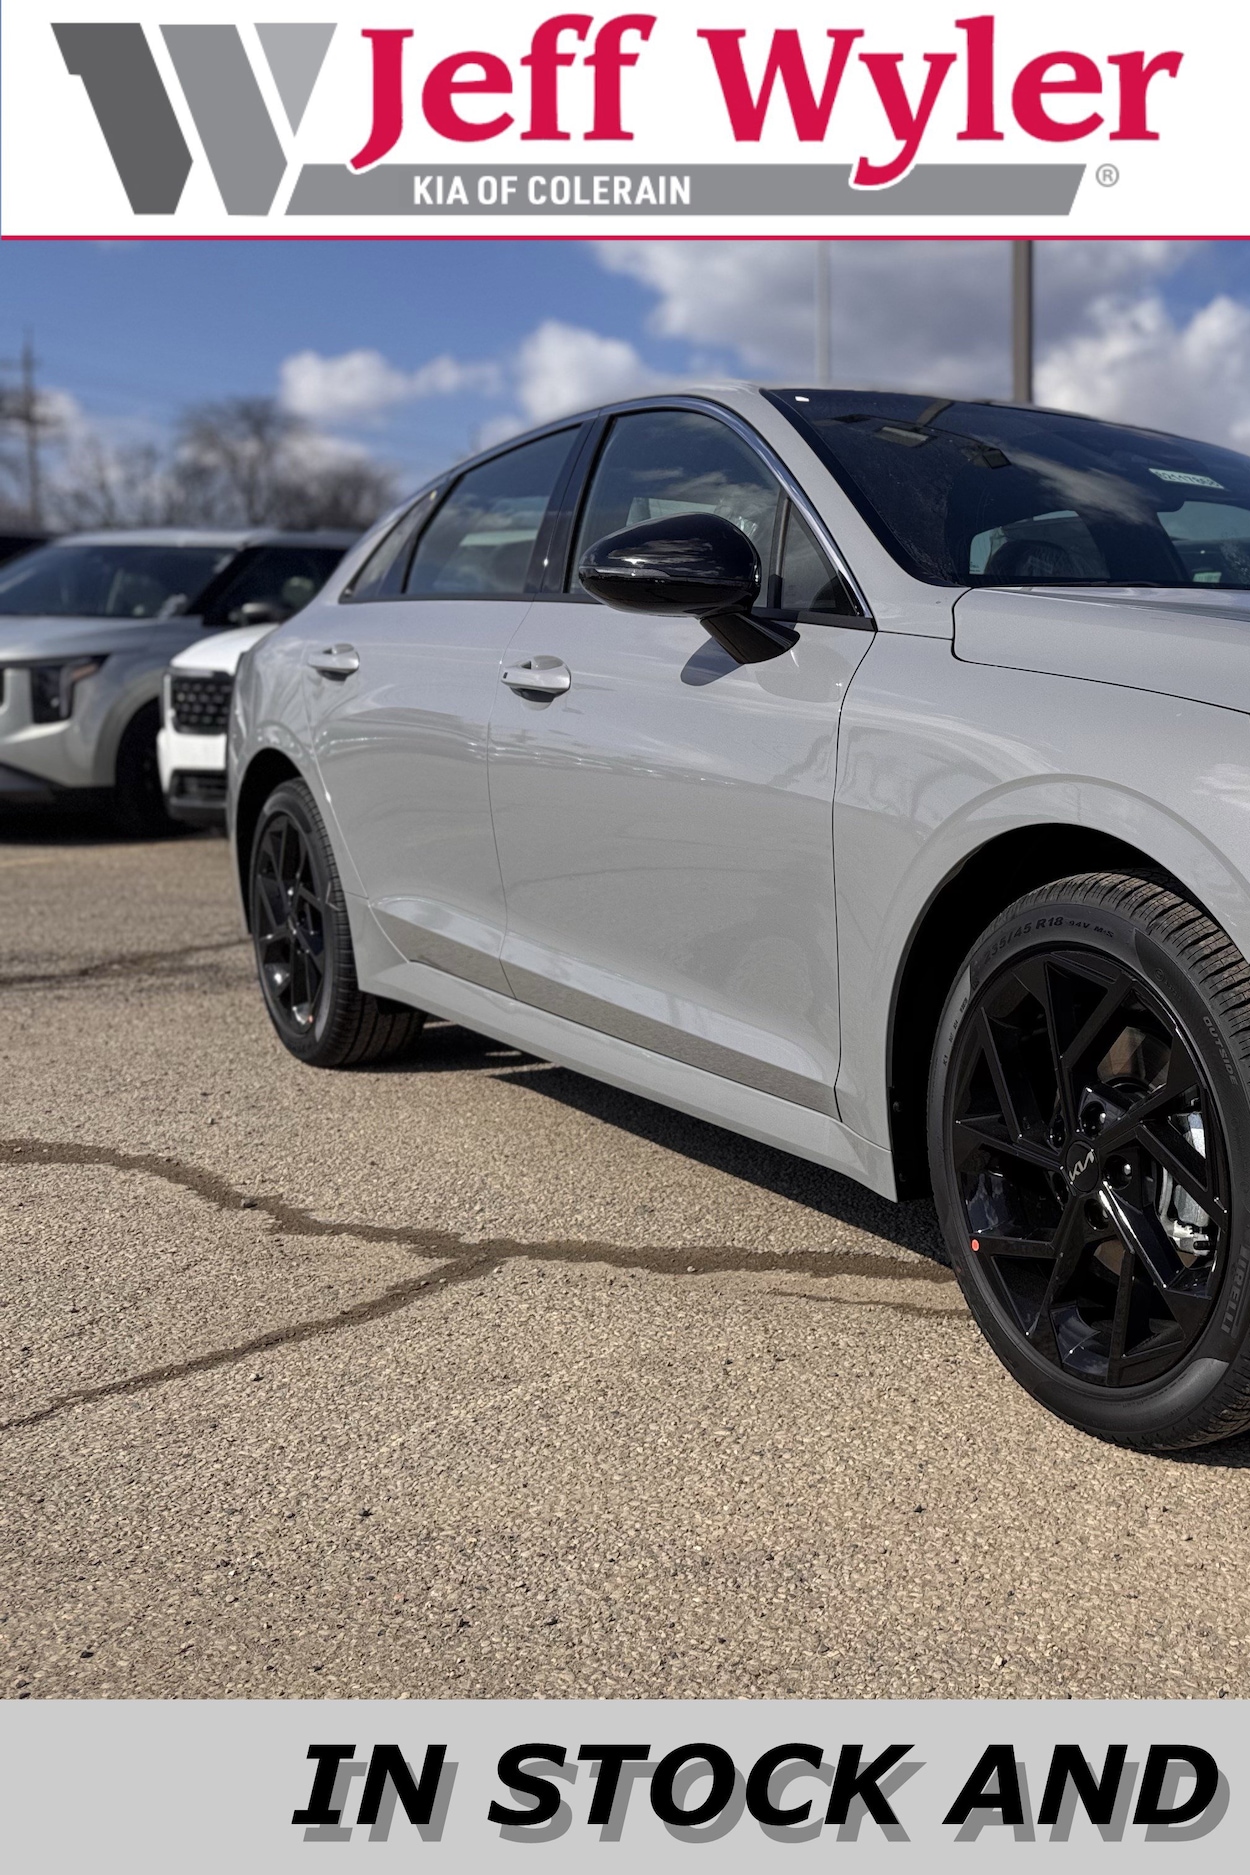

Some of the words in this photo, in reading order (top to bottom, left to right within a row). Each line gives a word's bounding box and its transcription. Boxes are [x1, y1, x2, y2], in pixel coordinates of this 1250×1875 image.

[983, 922, 1033, 965] 235/45
[1036, 916, 1064, 930] R18
[1203, 1015, 1238, 1085] OUTSIDE
